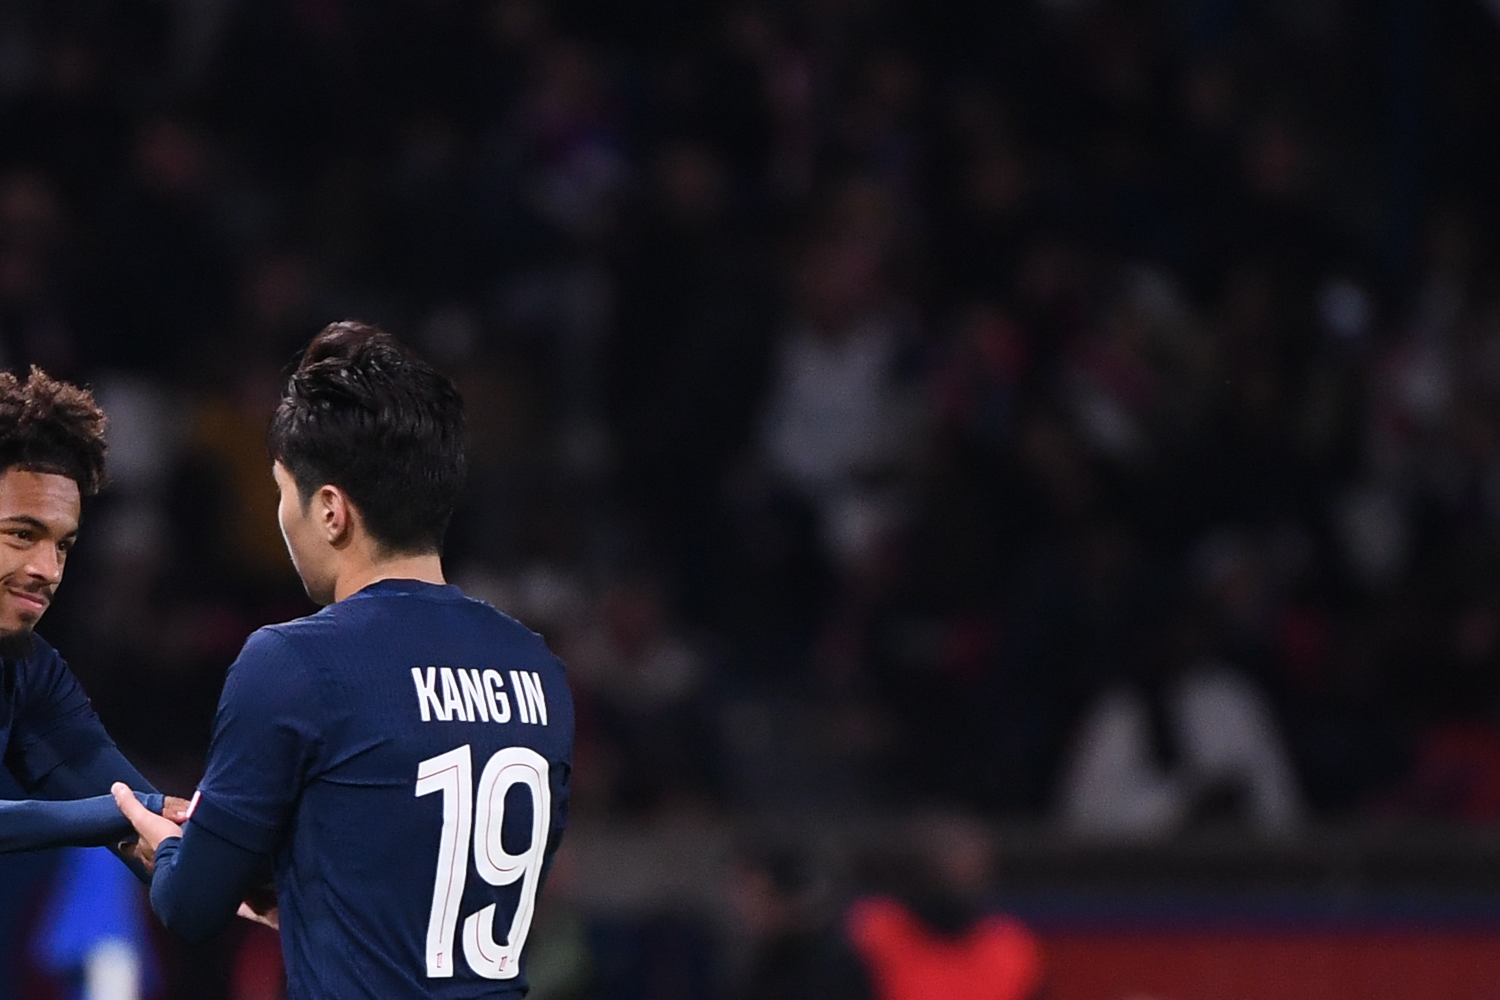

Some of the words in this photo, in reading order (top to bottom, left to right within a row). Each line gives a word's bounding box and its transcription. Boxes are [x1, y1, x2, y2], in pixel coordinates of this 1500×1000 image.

[411, 666, 512, 723] KANG
[509, 670, 548, 726] IN
[414, 744, 552, 980] 19
